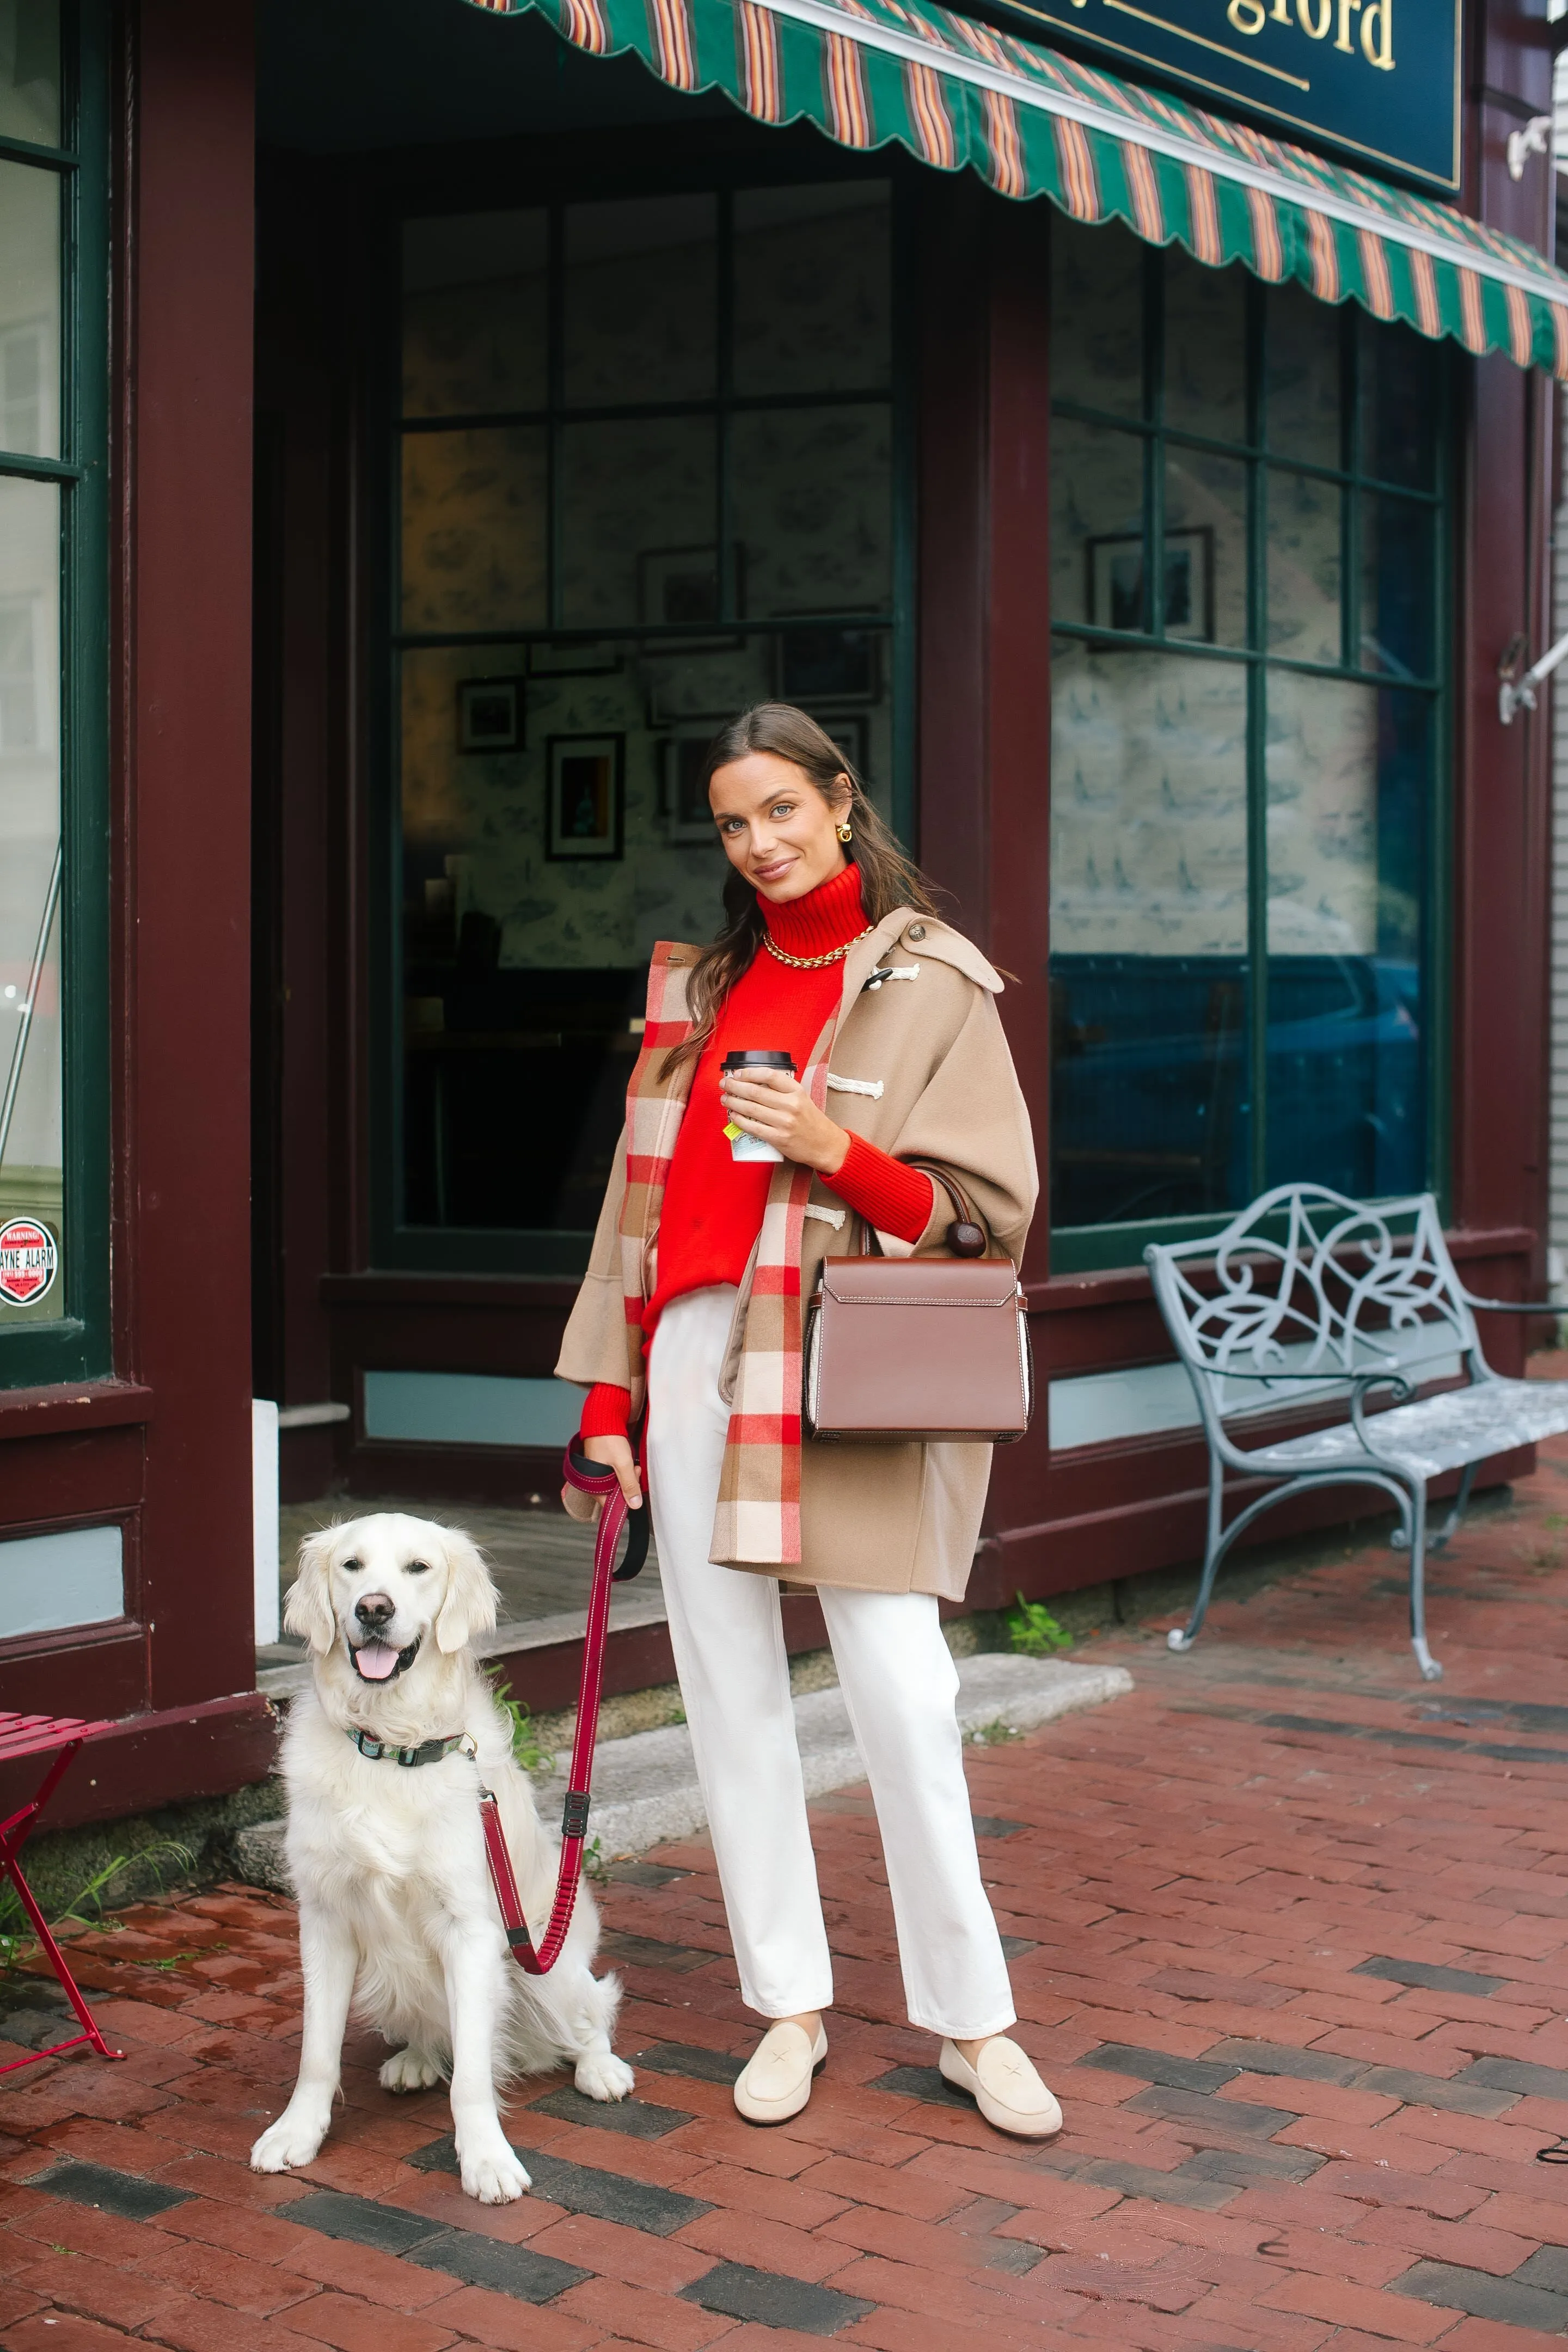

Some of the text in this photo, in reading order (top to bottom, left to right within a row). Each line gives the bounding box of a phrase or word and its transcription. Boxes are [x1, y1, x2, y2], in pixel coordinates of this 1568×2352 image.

[1227, 0, 1396, 71] ord
[6, 1230, 40, 1241] WARNING!
[26, 1249, 53, 1269] ALARM
